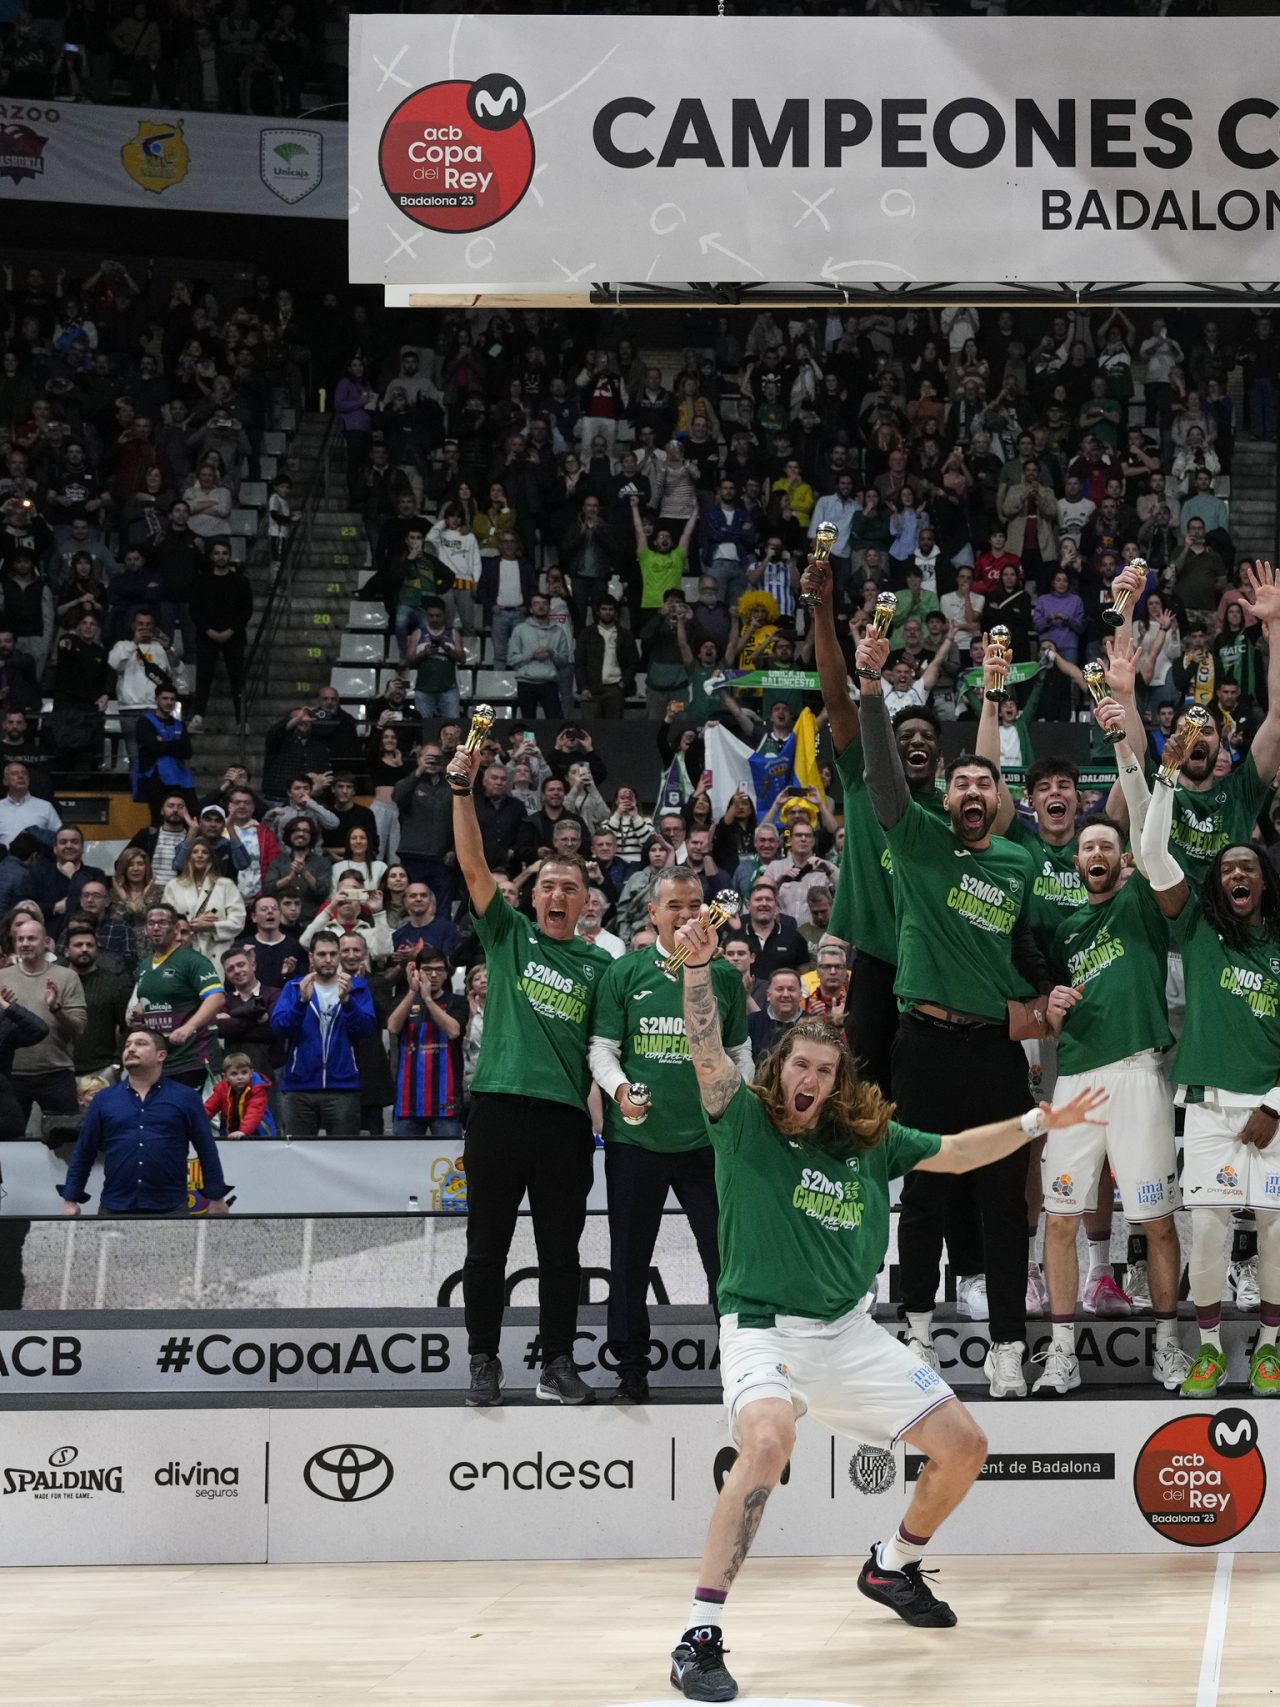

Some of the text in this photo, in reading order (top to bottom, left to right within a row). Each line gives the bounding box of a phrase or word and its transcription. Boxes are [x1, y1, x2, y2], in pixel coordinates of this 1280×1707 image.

[423, 126, 463, 141] acb
[592, 96, 1193, 169] CAMPEONES
[407, 141, 483, 168] Copa
[273, 166, 309, 177] Unicaja
[412, 164, 494, 194] del Rey
[399, 195, 456, 207] Badalona
[761, 677, 815, 687] BALONCESTO
[960, 873, 1006, 907] S2MOS
[946, 887, 1017, 935] CAMPEONES
[844, 1181, 860, 1190] 22
[845, 1190, 859, 1200] 23
[1137, 1191, 1164, 1205] laga
[157, 1333, 451, 1382] #CopaACB
[1009, 1460, 1026, 1473] de
[1032, 1460, 1101, 1473] Badalona
[1172, 1453, 1204, 1467] acb
[3, 1466, 125, 1494] SPALDING
[154, 1461, 239, 1486] divina
[449, 1451, 634, 1491] endesa
[1158, 1467, 1221, 1489] Copa
[195, 1489, 239, 1500] seguros
[1163, 1489, 1231, 1512] del Rey
[1152, 1514, 1200, 1523] Badalona
